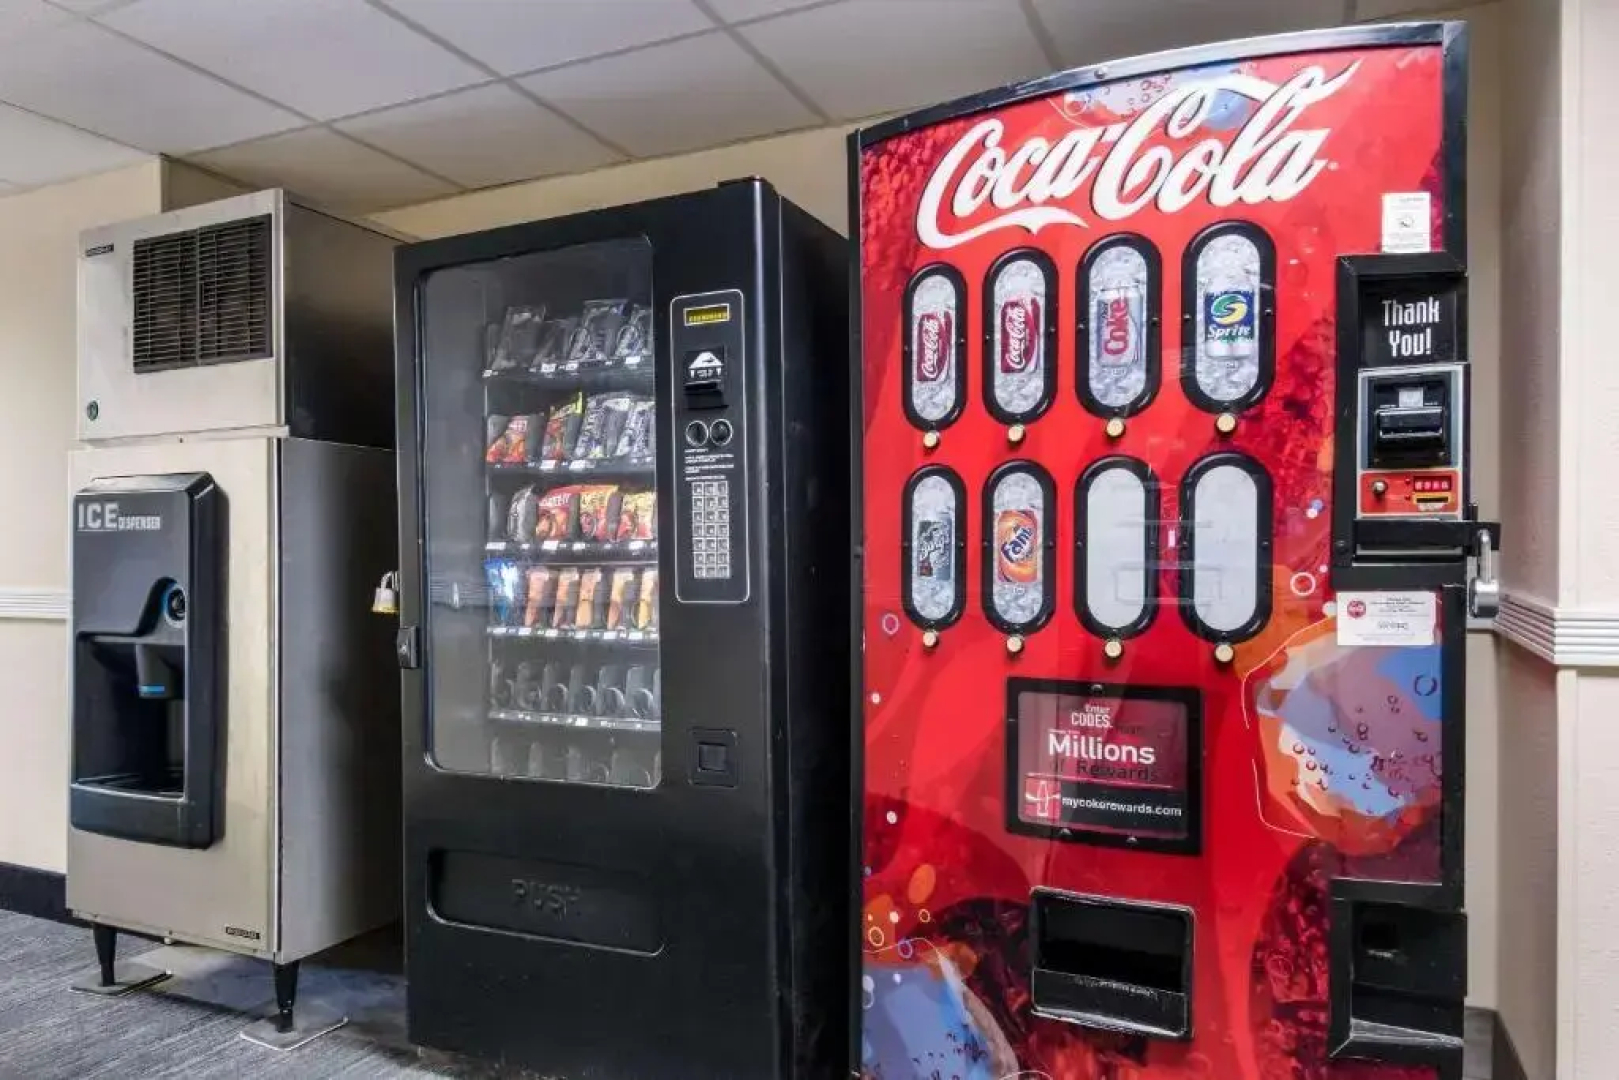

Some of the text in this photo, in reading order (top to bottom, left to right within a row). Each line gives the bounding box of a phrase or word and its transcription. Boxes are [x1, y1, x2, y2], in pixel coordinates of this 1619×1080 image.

[1382, 296, 1440, 326] Thank
[1104, 296, 1129, 355] Coke
[1207, 325, 1251, 340] Sprite
[1388, 327, 1432, 357] You!
[78, 503, 118, 530] ICE
[1085, 703, 1110, 714] Enter
[1049, 732, 1156, 764] Millions
[1077, 760, 1158, 782] Rewards
[1062, 795, 1182, 817] mycokerewards.com
